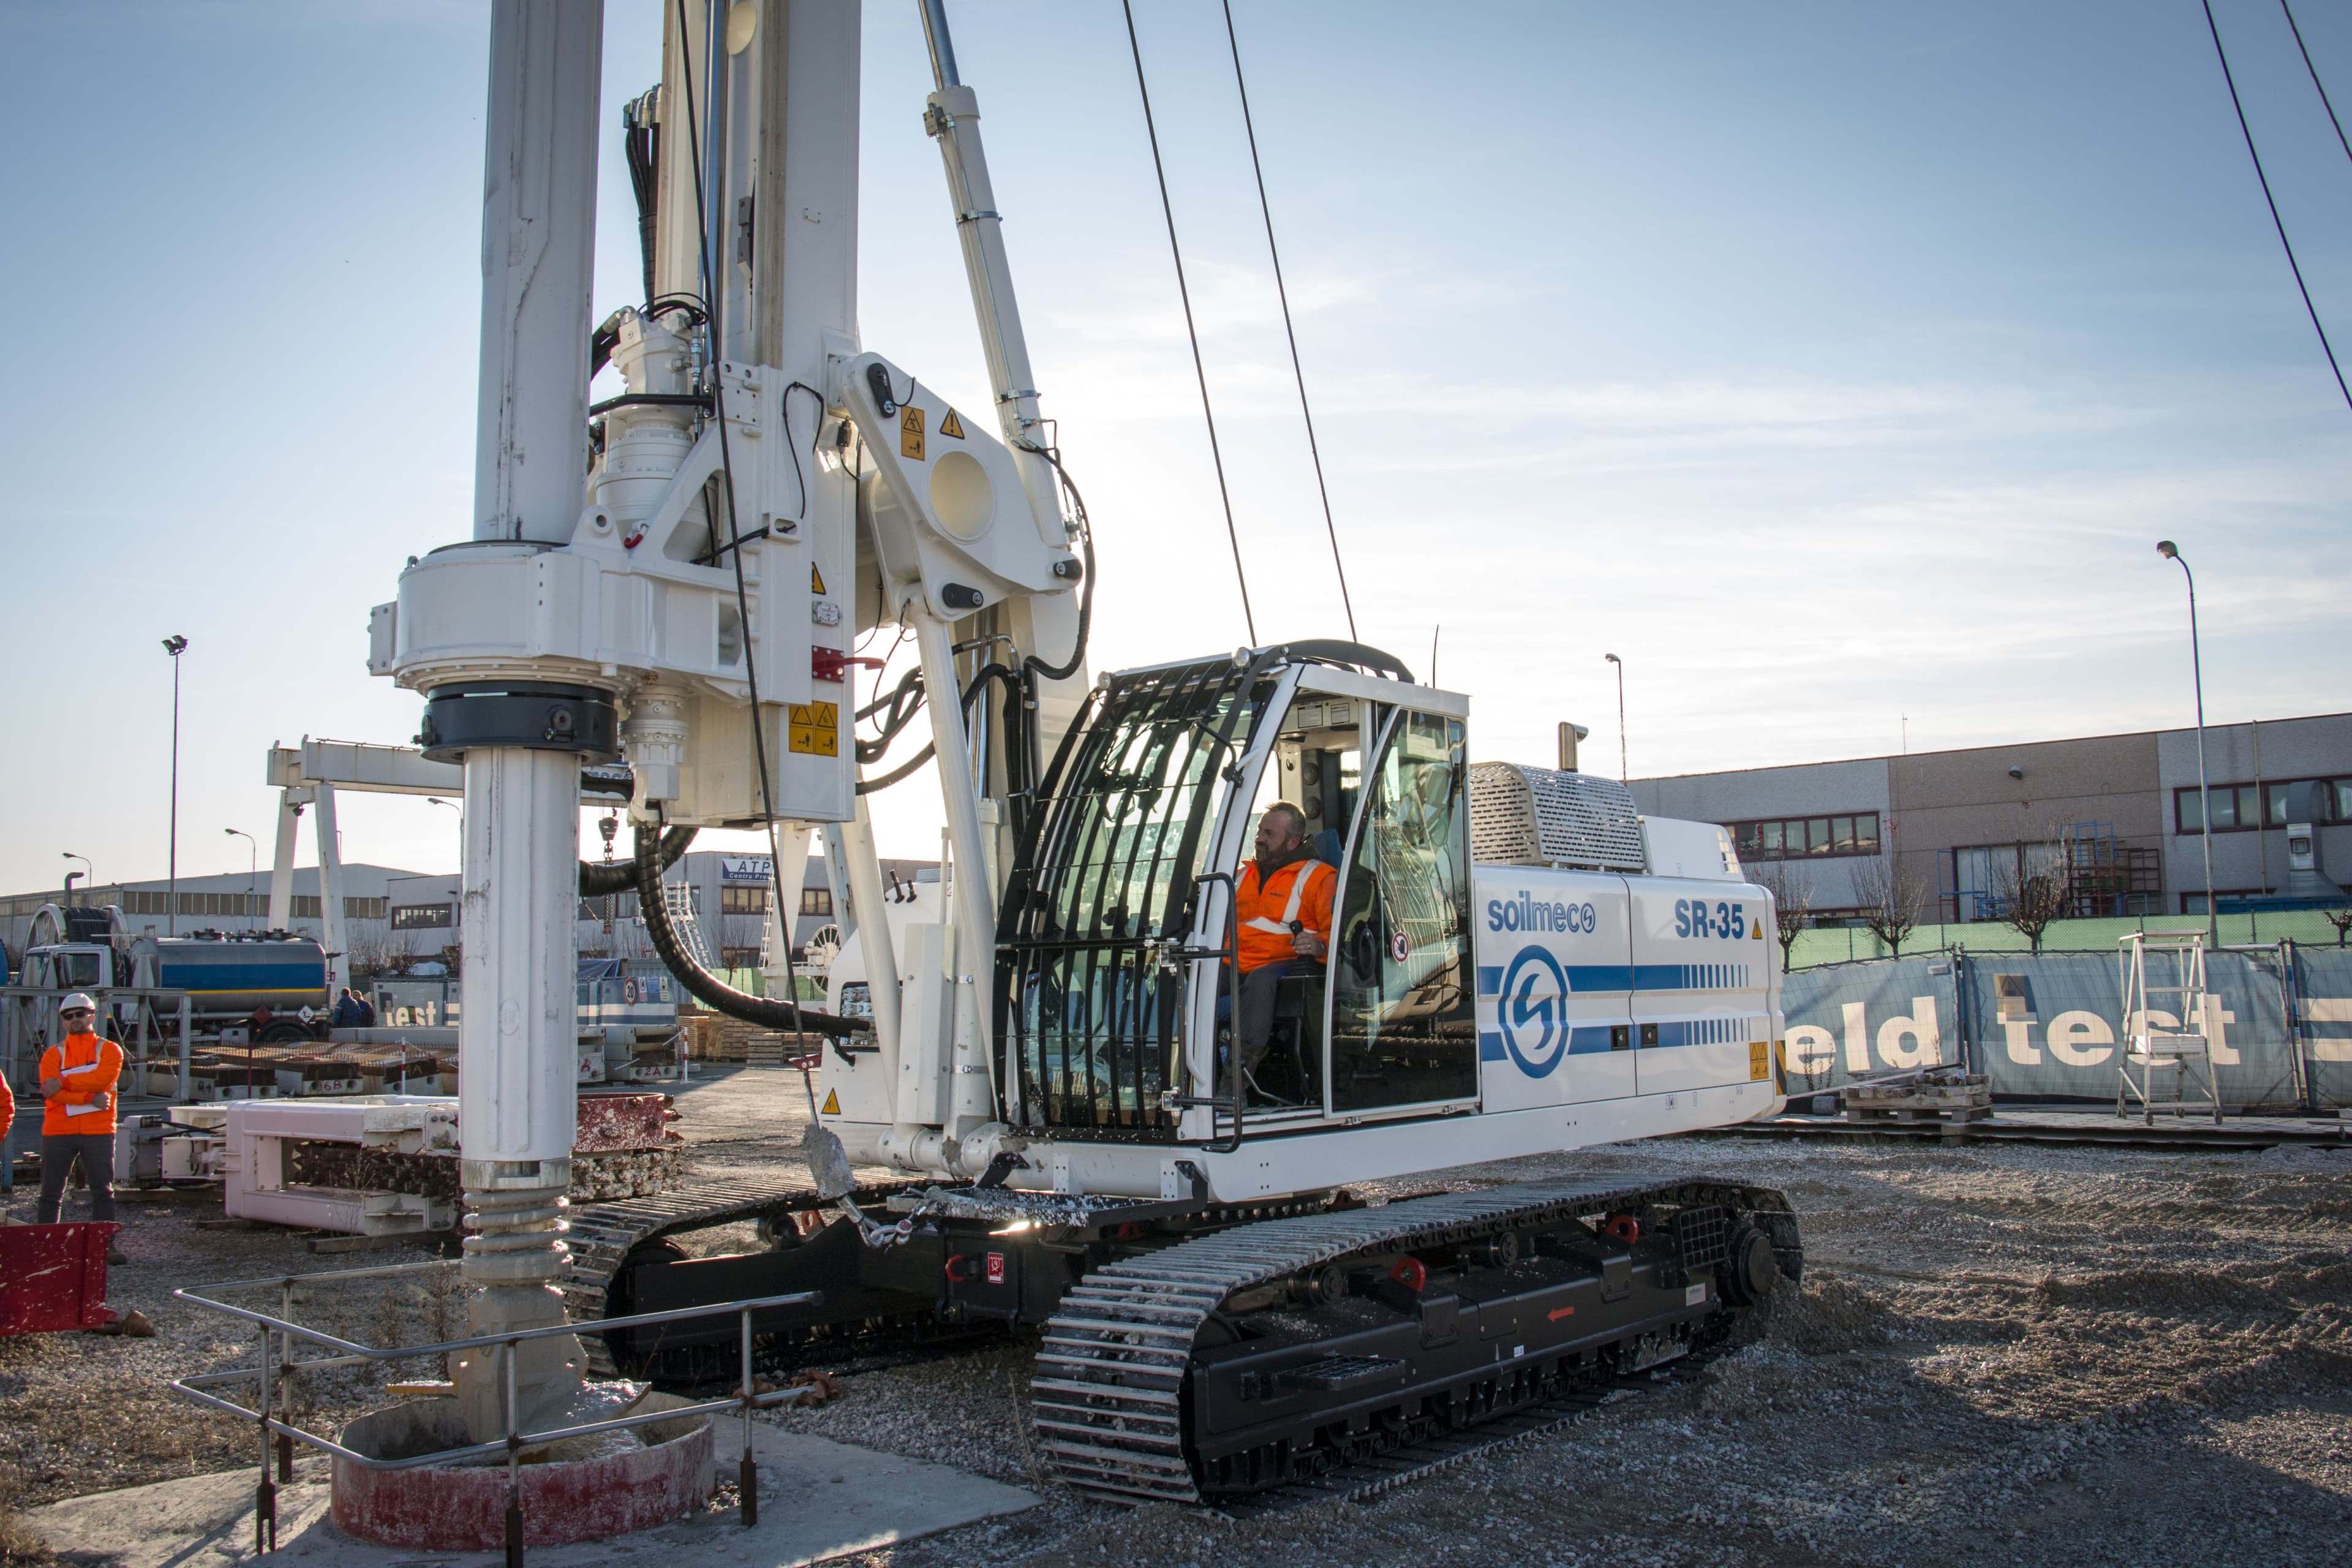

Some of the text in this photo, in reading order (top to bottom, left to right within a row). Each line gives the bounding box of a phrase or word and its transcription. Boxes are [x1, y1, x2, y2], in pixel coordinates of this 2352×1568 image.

[738, 861, 771, 872] ATP
[1488, 891, 1596, 934] soilmeco
[1675, 899, 1744, 940] SR-35
[627, 986, 634, 998] 20
[645, 1067, 662, 1077] 2A
